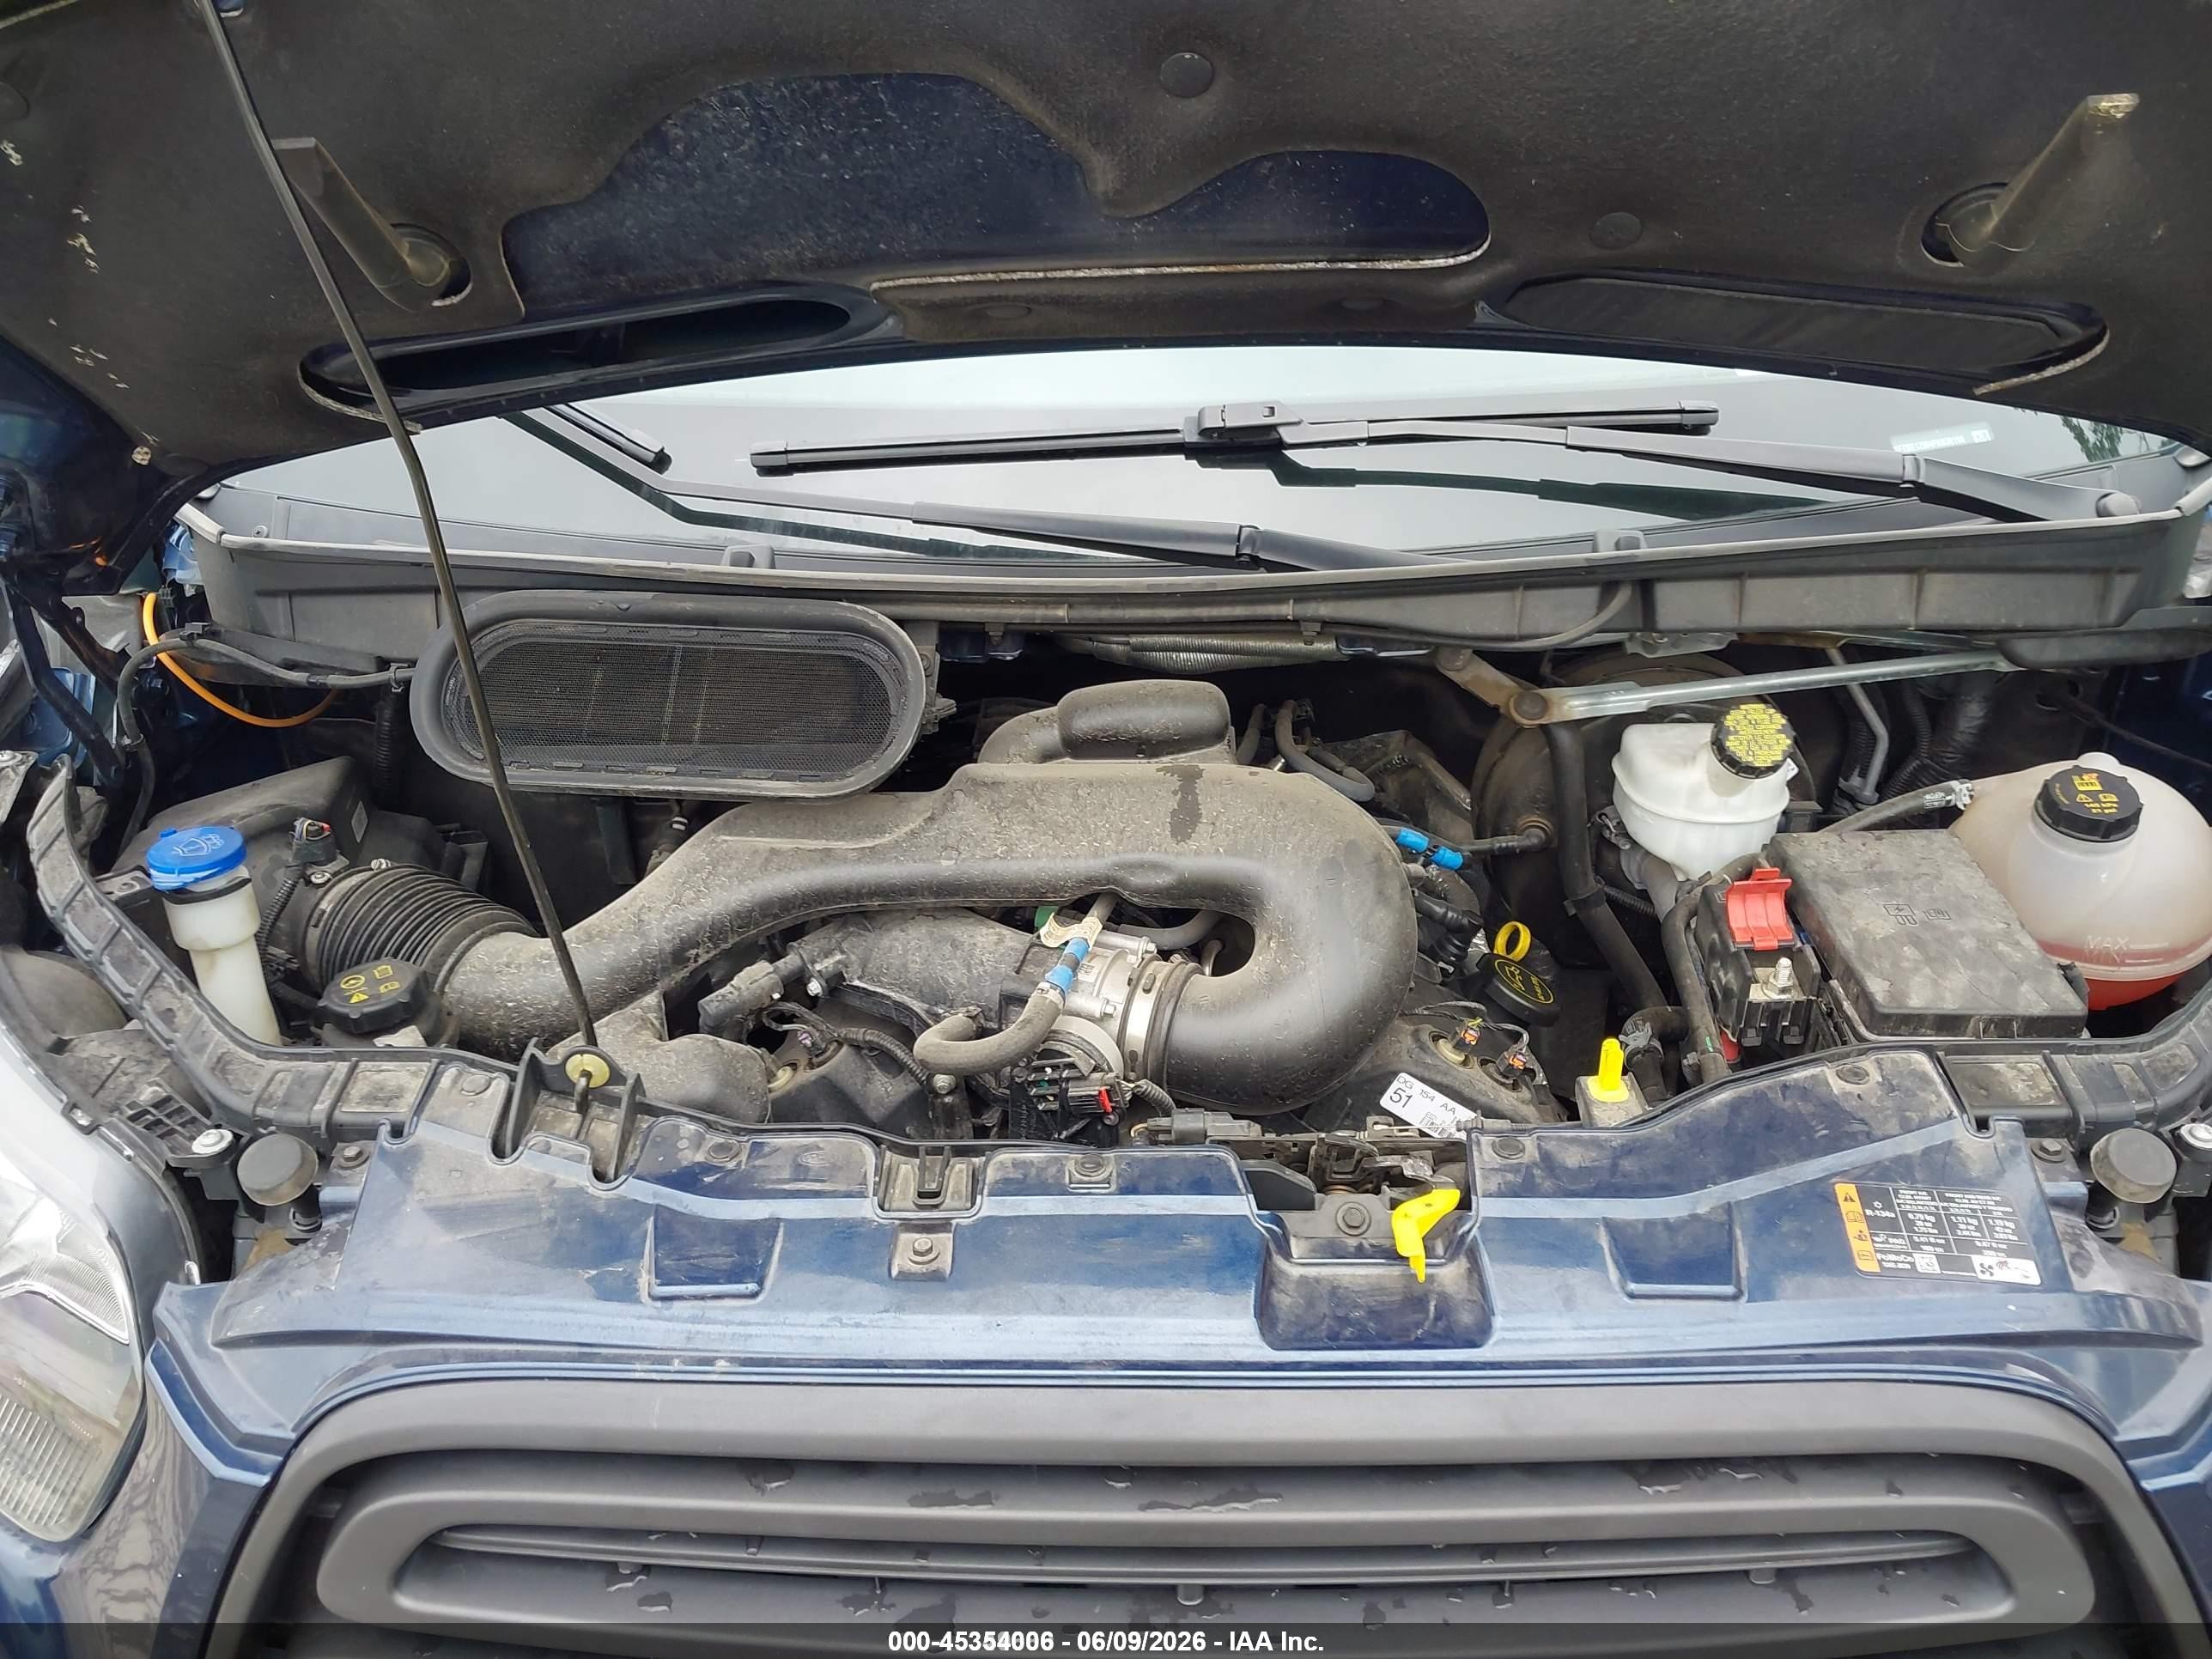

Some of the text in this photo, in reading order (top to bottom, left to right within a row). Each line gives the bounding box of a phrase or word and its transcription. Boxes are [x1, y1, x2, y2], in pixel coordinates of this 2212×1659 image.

[2085, 935, 2130, 951] MAX
[1390, 1088, 1413, 1108] 51
[1397, 1075, 1455, 1115] DG 154 AA
[1865, 1209, 1896, 1218] R-134a
[1925, 1213, 1936, 1222] kg
[1876, 1253, 1914, 1262] FoMoCo
